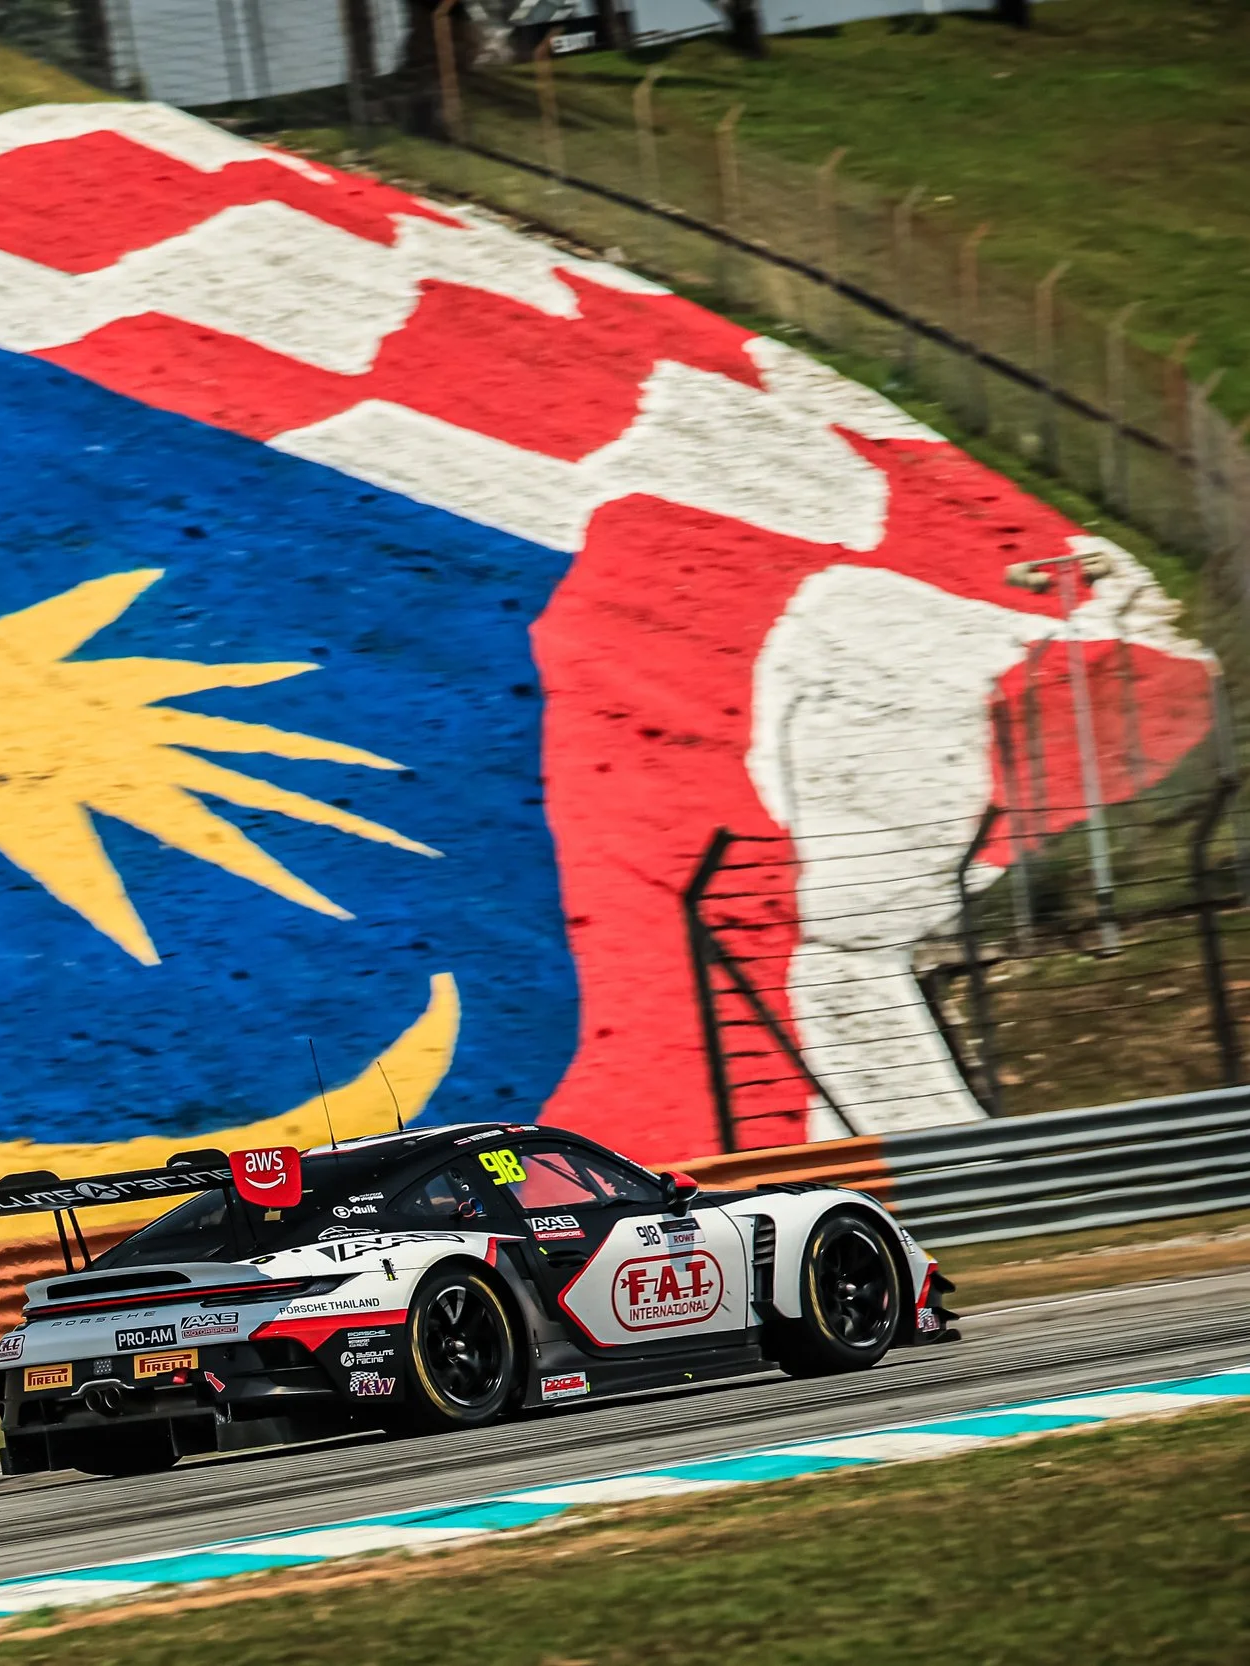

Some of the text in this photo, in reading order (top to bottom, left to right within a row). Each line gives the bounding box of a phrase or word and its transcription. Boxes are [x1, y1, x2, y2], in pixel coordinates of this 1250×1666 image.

[245, 1150, 284, 1173] aws
[478, 1149, 526, 1185] 918
[531, 1215, 580, 1232] AAS
[636, 1225, 661, 1246] 918
[673, 1232, 695, 1244] ROWE
[279, 1297, 380, 1316] PORSCHE THAILAND
[629, 1300, 710, 1322] INTERNATIONAL
[50, 1310, 157, 1328] PORSCHE
[182, 1312, 238, 1329] AAS
[118, 1328, 174, 1348] PRO-AM
[183, 1325, 238, 1339] MOTORSPORT
[347, 1329, 386, 1338] PORSCHE
[139, 1353, 192, 1374] PIRELLI
[27, 1367, 69, 1387] PIRELLI
[357, 1377, 396, 1396] KW
